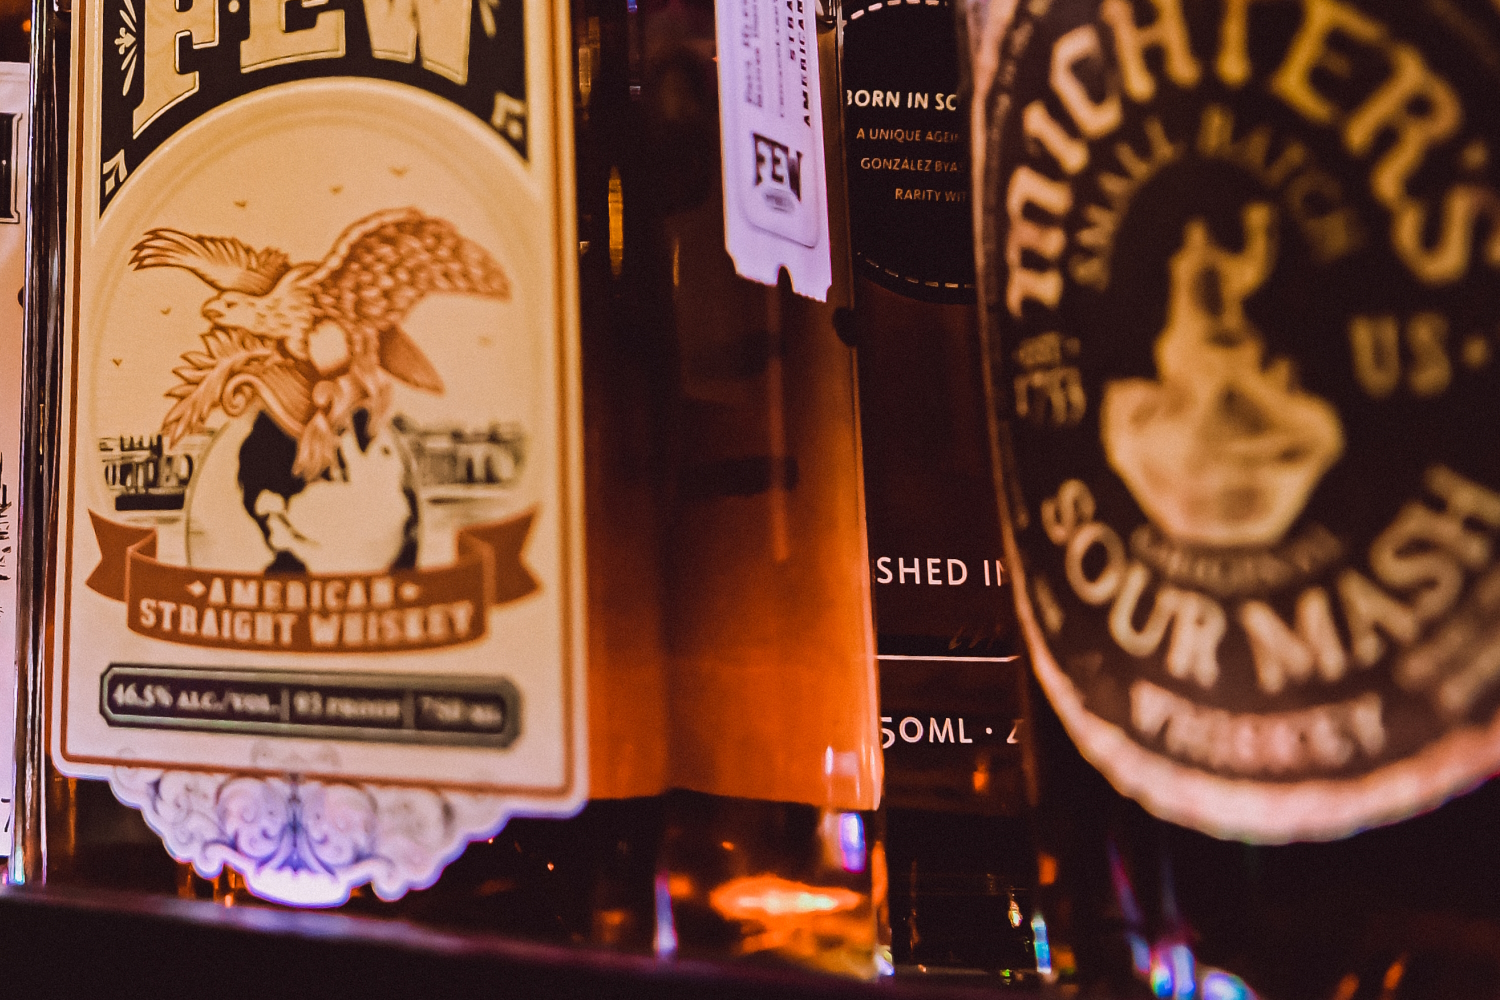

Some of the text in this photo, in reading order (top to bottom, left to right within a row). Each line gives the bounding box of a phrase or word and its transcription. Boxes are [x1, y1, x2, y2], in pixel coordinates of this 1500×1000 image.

[906, 91, 929, 110] IN
[856, 127, 866, 140] A
[869, 128, 921, 143] UNIQUE
[935, 160, 963, 174] BYA
[895, 188, 942, 202] RARITY
[1039, 477, 1228, 690] SOUR
[1240, 461, 1500, 695] MASH
[206, 575, 399, 610] AMERICAN
[139, 599, 475, 648] STRAIGHT WHISKEY
